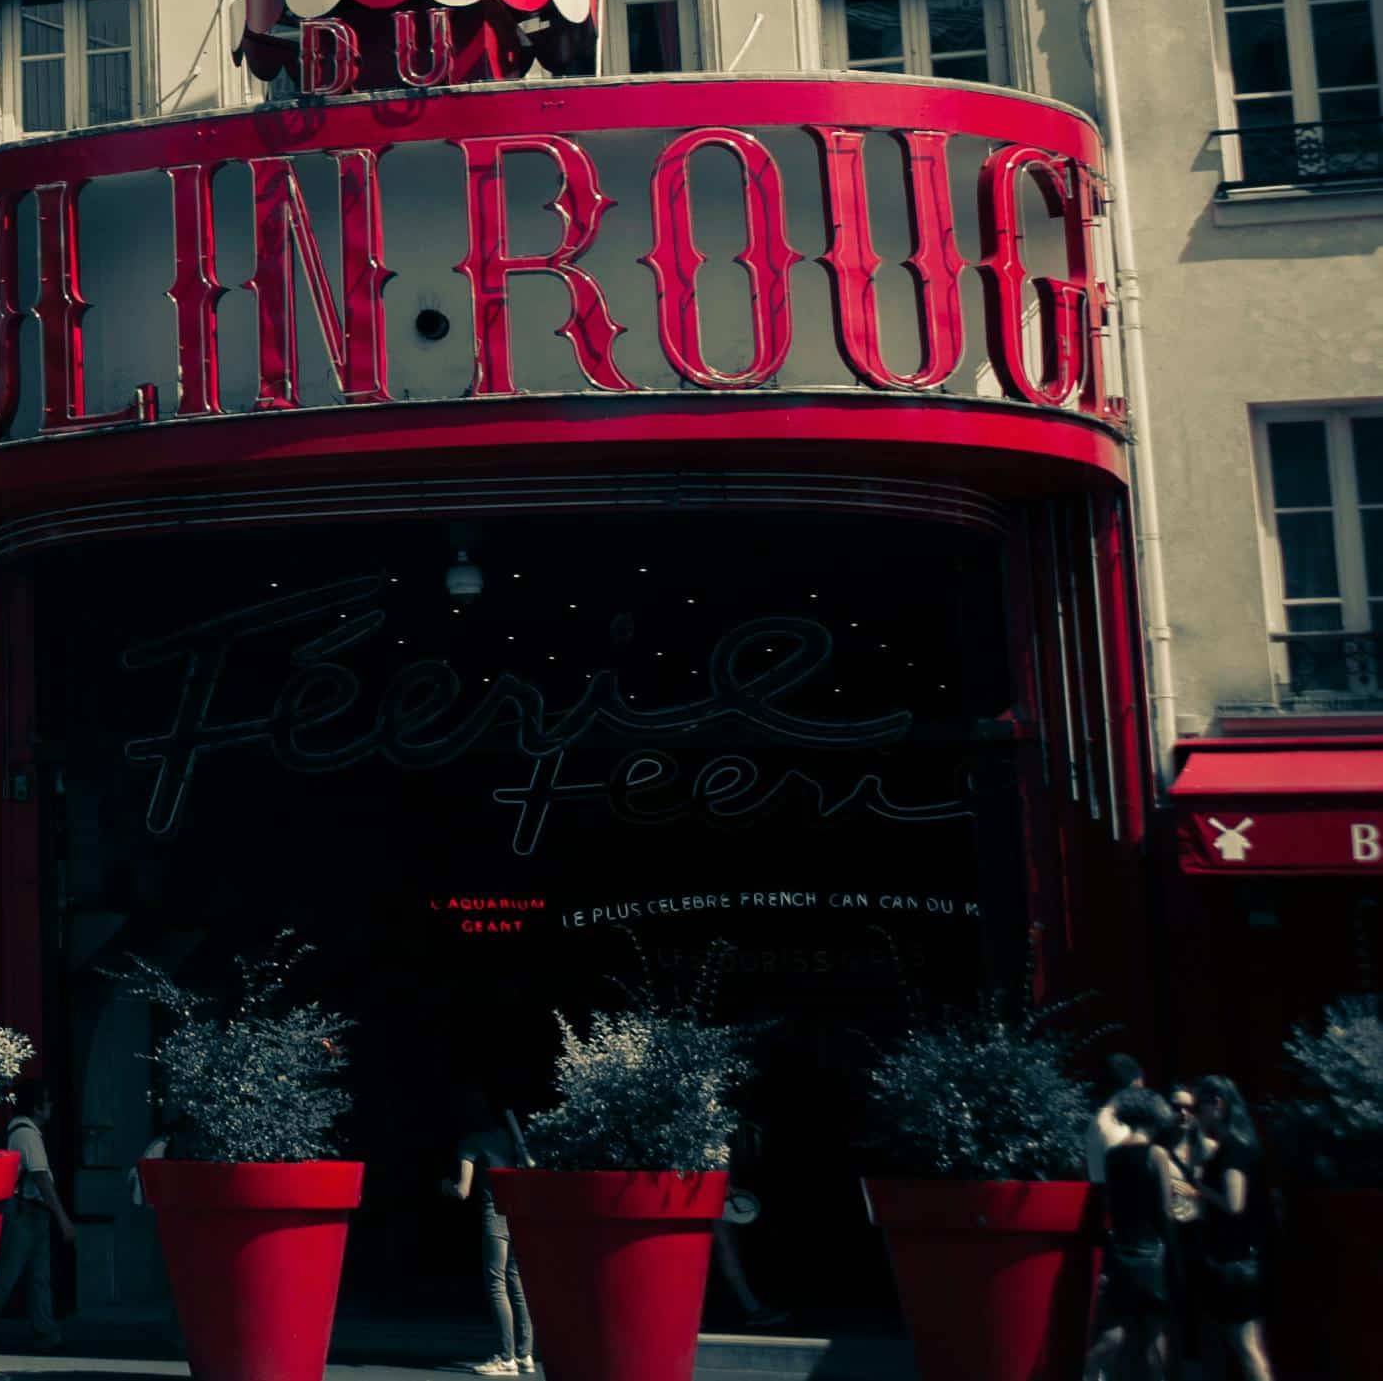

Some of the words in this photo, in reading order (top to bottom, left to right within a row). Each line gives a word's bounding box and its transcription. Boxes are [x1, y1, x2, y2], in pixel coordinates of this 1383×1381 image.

[300, 8, 452, 94] DU
[592, 900, 642, 924] PLUS
[739, 891, 817, 908] FRENCH
[828, 892, 869, 908] CAN
[879, 893, 919, 910] CAN
[926, 896, 954, 914] DU
